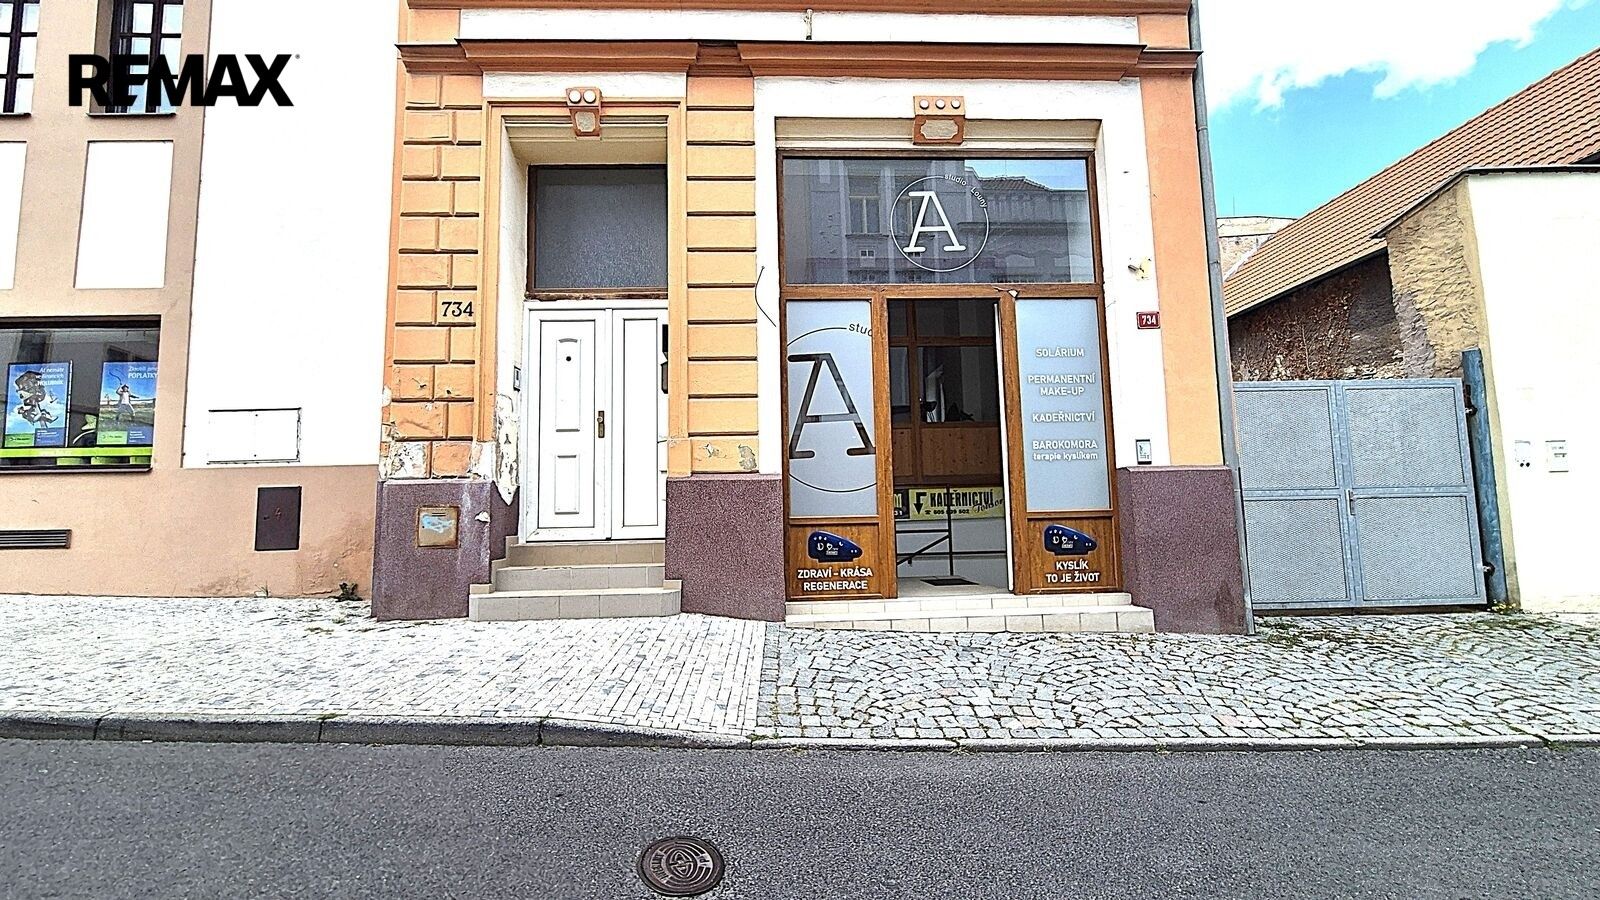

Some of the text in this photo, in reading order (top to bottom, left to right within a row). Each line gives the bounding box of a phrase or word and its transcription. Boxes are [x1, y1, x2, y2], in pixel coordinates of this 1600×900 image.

[944, 174, 988, 208] studio Louny
[903, 191, 966, 252] A
[441, 301, 475, 317] 734
[1141, 314, 1156, 325] 734
[1035, 346, 1085, 357] SOLÁRIUM
[1027, 372, 1096, 384] PERMANENTNÍ
[1040, 386, 1085, 396] MAKE-UP
[787, 353, 876, 459] A
[1032, 410, 1096, 422] KADEŘNICTVÍ
[1032, 439, 1098, 450] BAROKOMORA
[1033, 451, 1098, 462] terapie kyslíkem
[930, 489, 994, 507] KADEŘNICTVÍ
[1055, 559, 1089, 571] KYSLÍK
[797, 566, 833, 579] ZDRAVÍ
[840, 566, 873, 578] KRÁSA
[1045, 570, 1100, 583] TO JE ŽIVOT
[803, 580, 868, 591] REGENERACE
